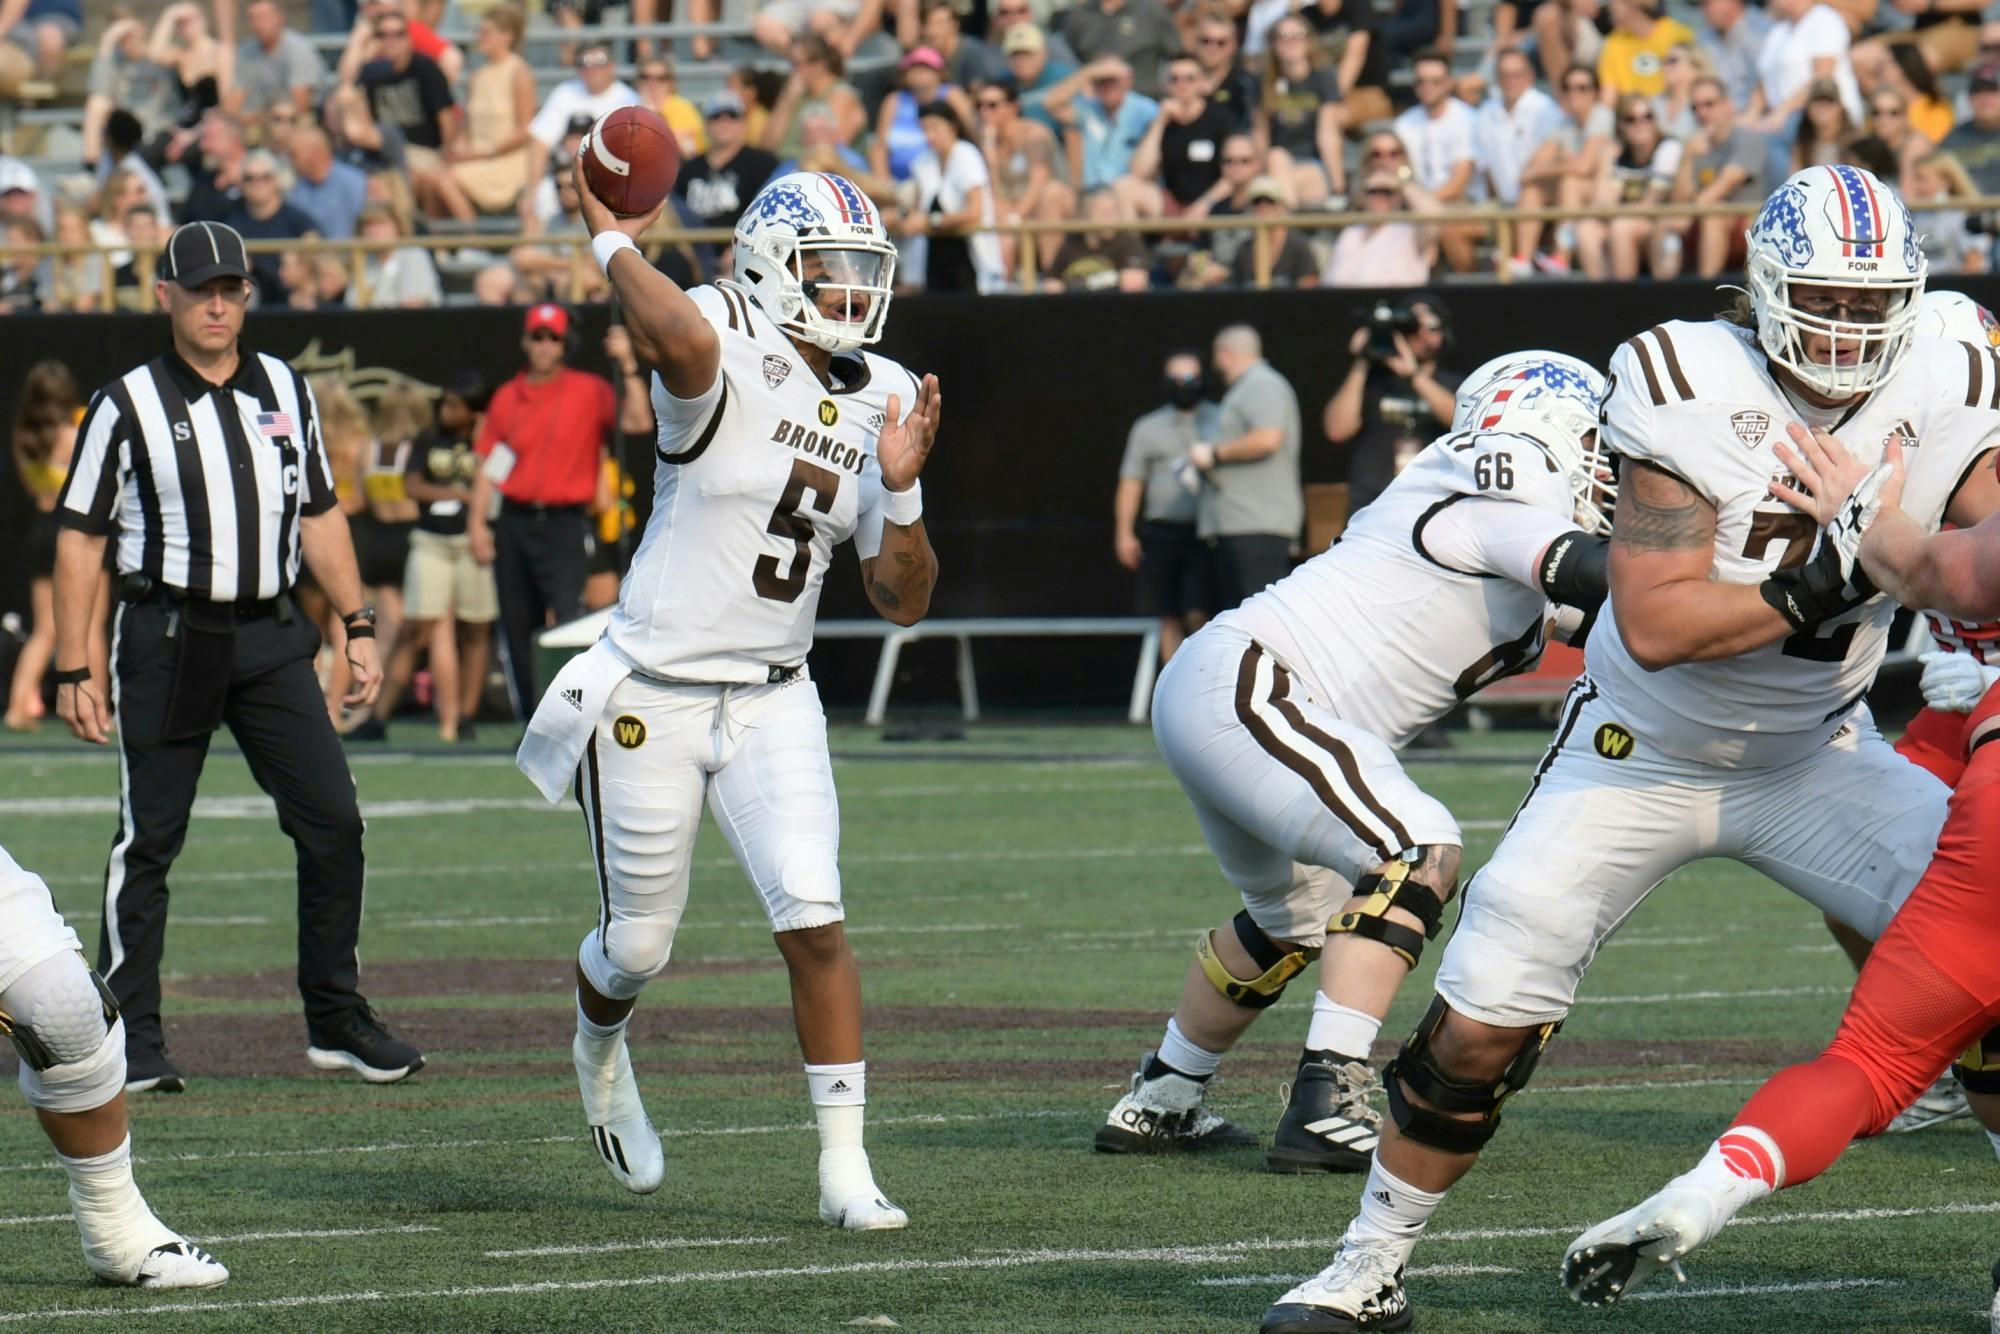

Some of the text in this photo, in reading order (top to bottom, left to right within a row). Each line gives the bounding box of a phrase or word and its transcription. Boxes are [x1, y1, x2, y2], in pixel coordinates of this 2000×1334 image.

[850, 226, 874, 235] FOUR
[1847, 261, 1878, 271] FOUR
[173, 421, 191, 441] S
[1882, 437, 1920, 448] adas
[770, 419, 868, 475] BRONCOS
[282, 464, 298, 495] C
[1474, 451, 1514, 491] 66
[752, 457, 840, 604] 5
[560, 691, 583, 712] adidas
[617, 721, 641, 745] W
[1602, 727, 1630, 757] W
